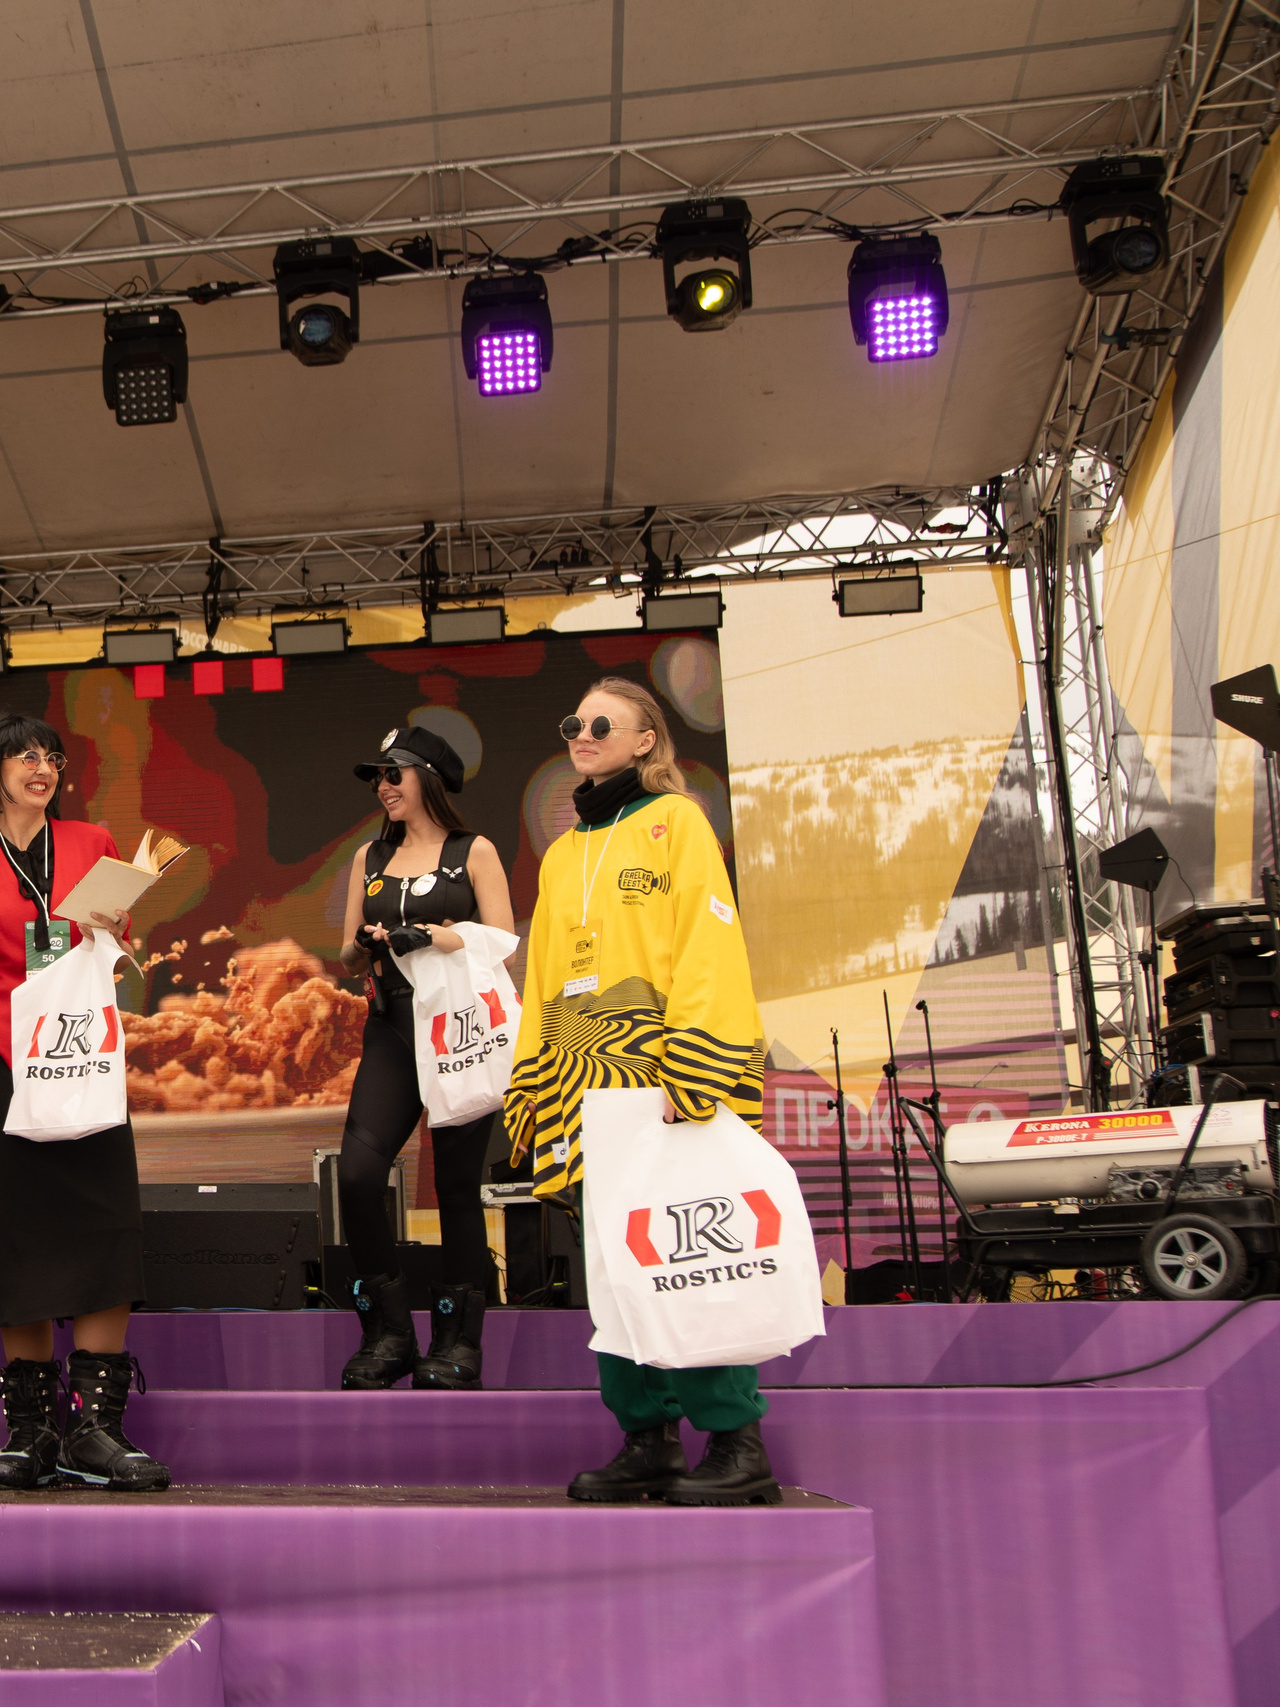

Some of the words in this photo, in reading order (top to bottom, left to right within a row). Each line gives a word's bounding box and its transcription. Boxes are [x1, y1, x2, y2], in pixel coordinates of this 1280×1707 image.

[1231, 693, 1265, 705] SHURE
[623, 878, 642, 888] FEST
[624, 870, 651, 883] GRELKA
[42, 953, 55, 963] 50
[438, 1033, 509, 1074] ROSTC'S
[1023, 1122, 1090, 1134] KERONA
[1098, 1114, 1163, 1129] 30000
[667, 1196, 744, 1264] R
[652, 1258, 778, 1292] ROSTIC'S
